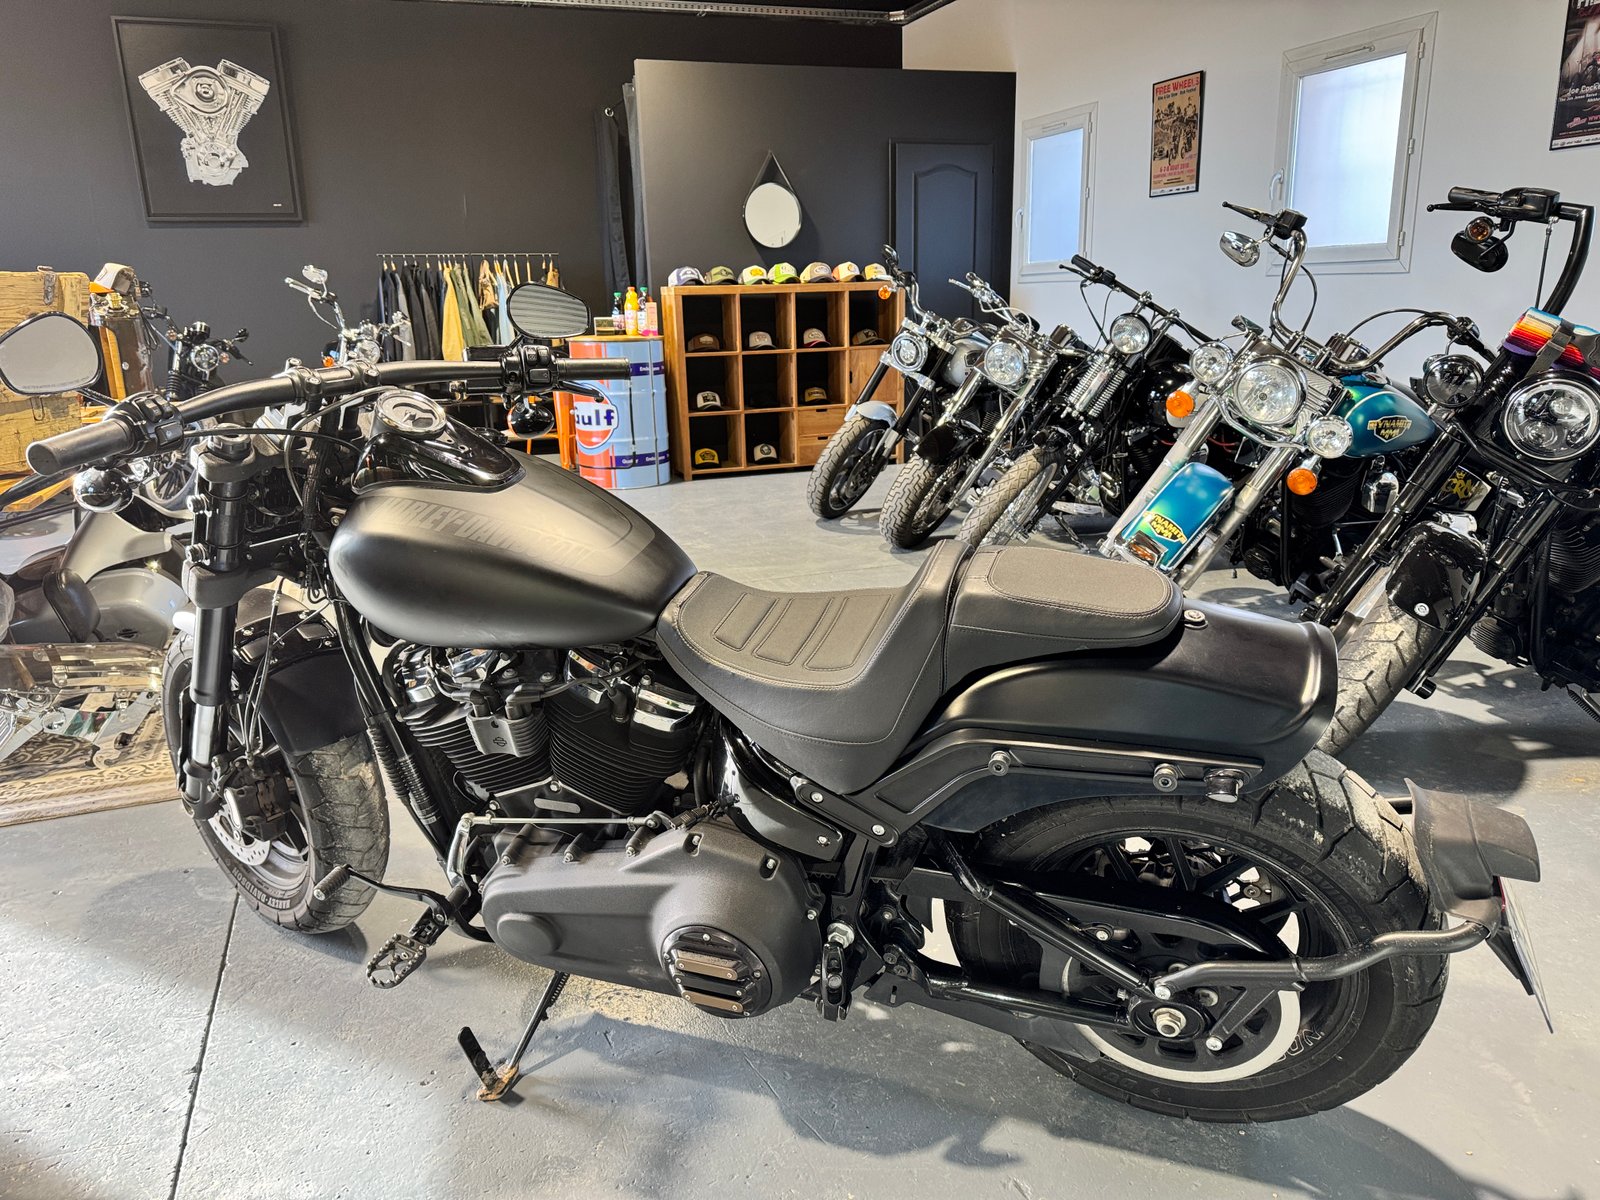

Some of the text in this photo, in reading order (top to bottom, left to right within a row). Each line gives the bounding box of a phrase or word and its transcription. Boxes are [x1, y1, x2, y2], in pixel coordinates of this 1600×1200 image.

[1155, 76, 1199, 96] FREE WHEELS
[1567, 87, 1579, 96] Joe
